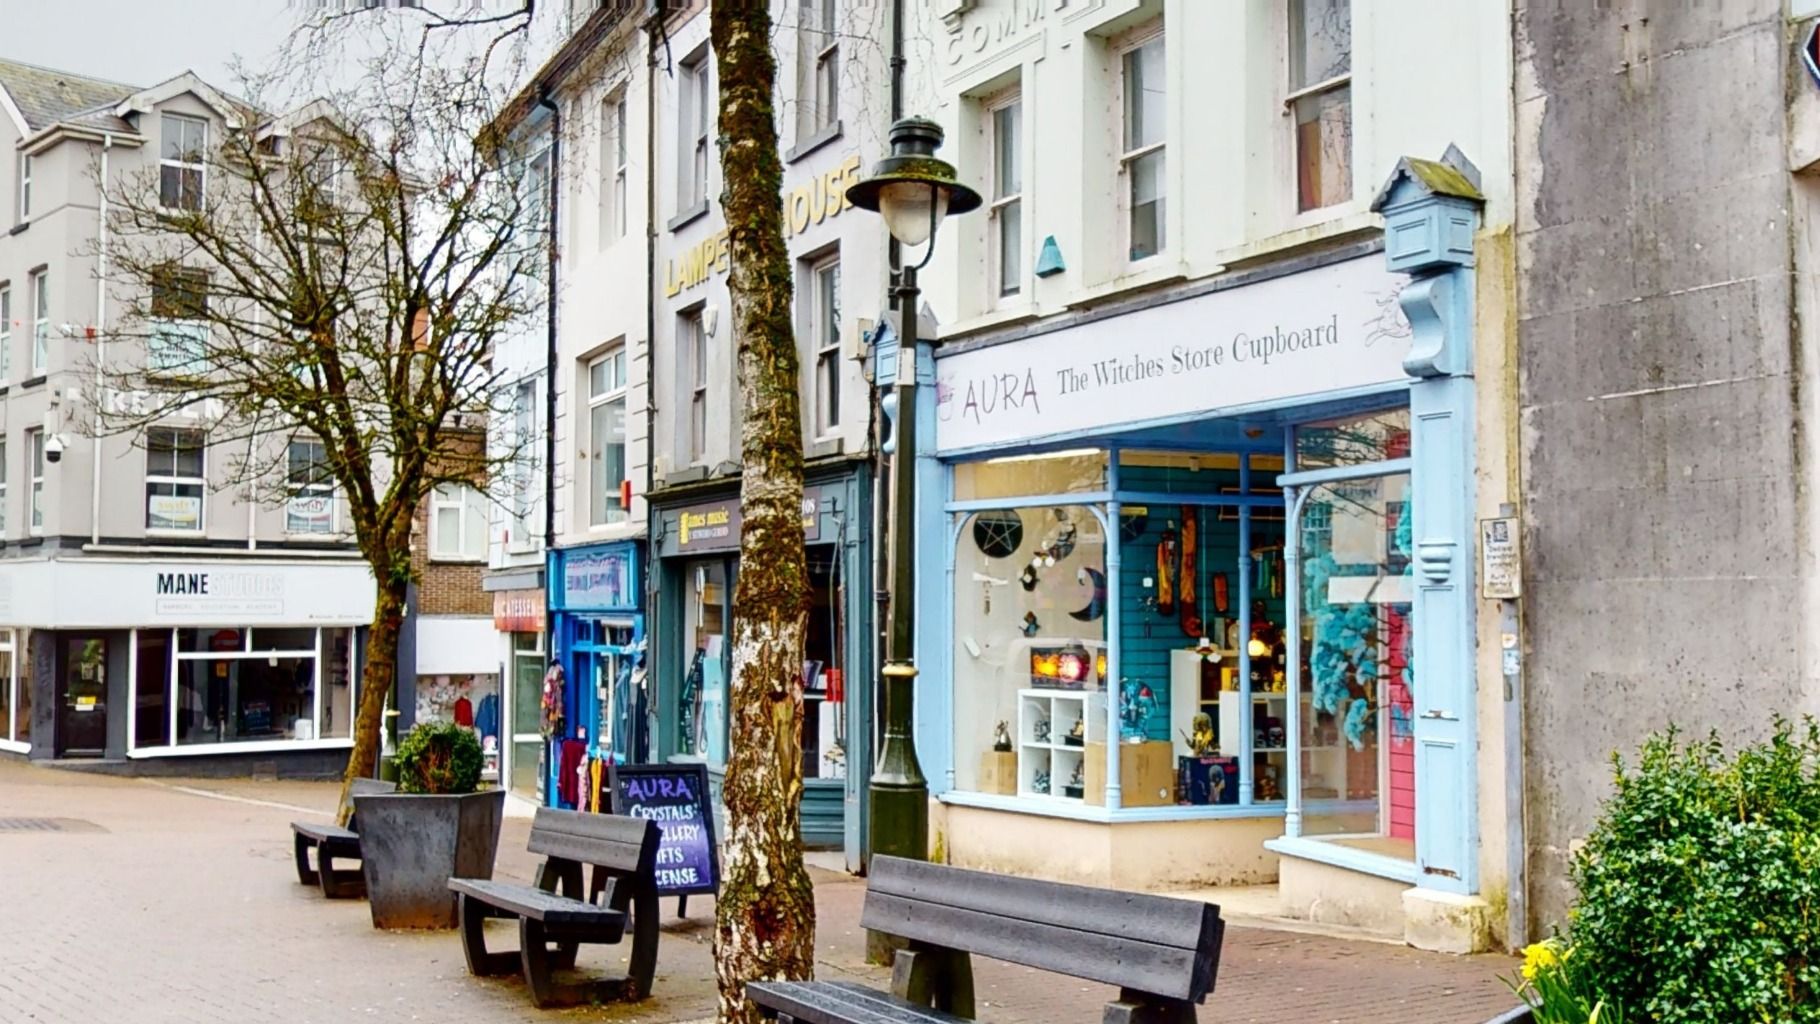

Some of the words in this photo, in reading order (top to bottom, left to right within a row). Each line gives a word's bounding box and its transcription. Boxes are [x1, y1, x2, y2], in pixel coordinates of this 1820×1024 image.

[665, 228, 730, 299] LAMPE
[962, 367, 1041, 425] AURA
[1057, 367, 1089, 397] The
[1093, 356, 1165, 388] Witches
[1171, 344, 1225, 376] Store
[1231, 314, 1339, 368] Cupboard
[156, 573, 209, 595] MANE
[627, 776, 694, 801] AURA
[655, 867, 698, 886] CENSE
